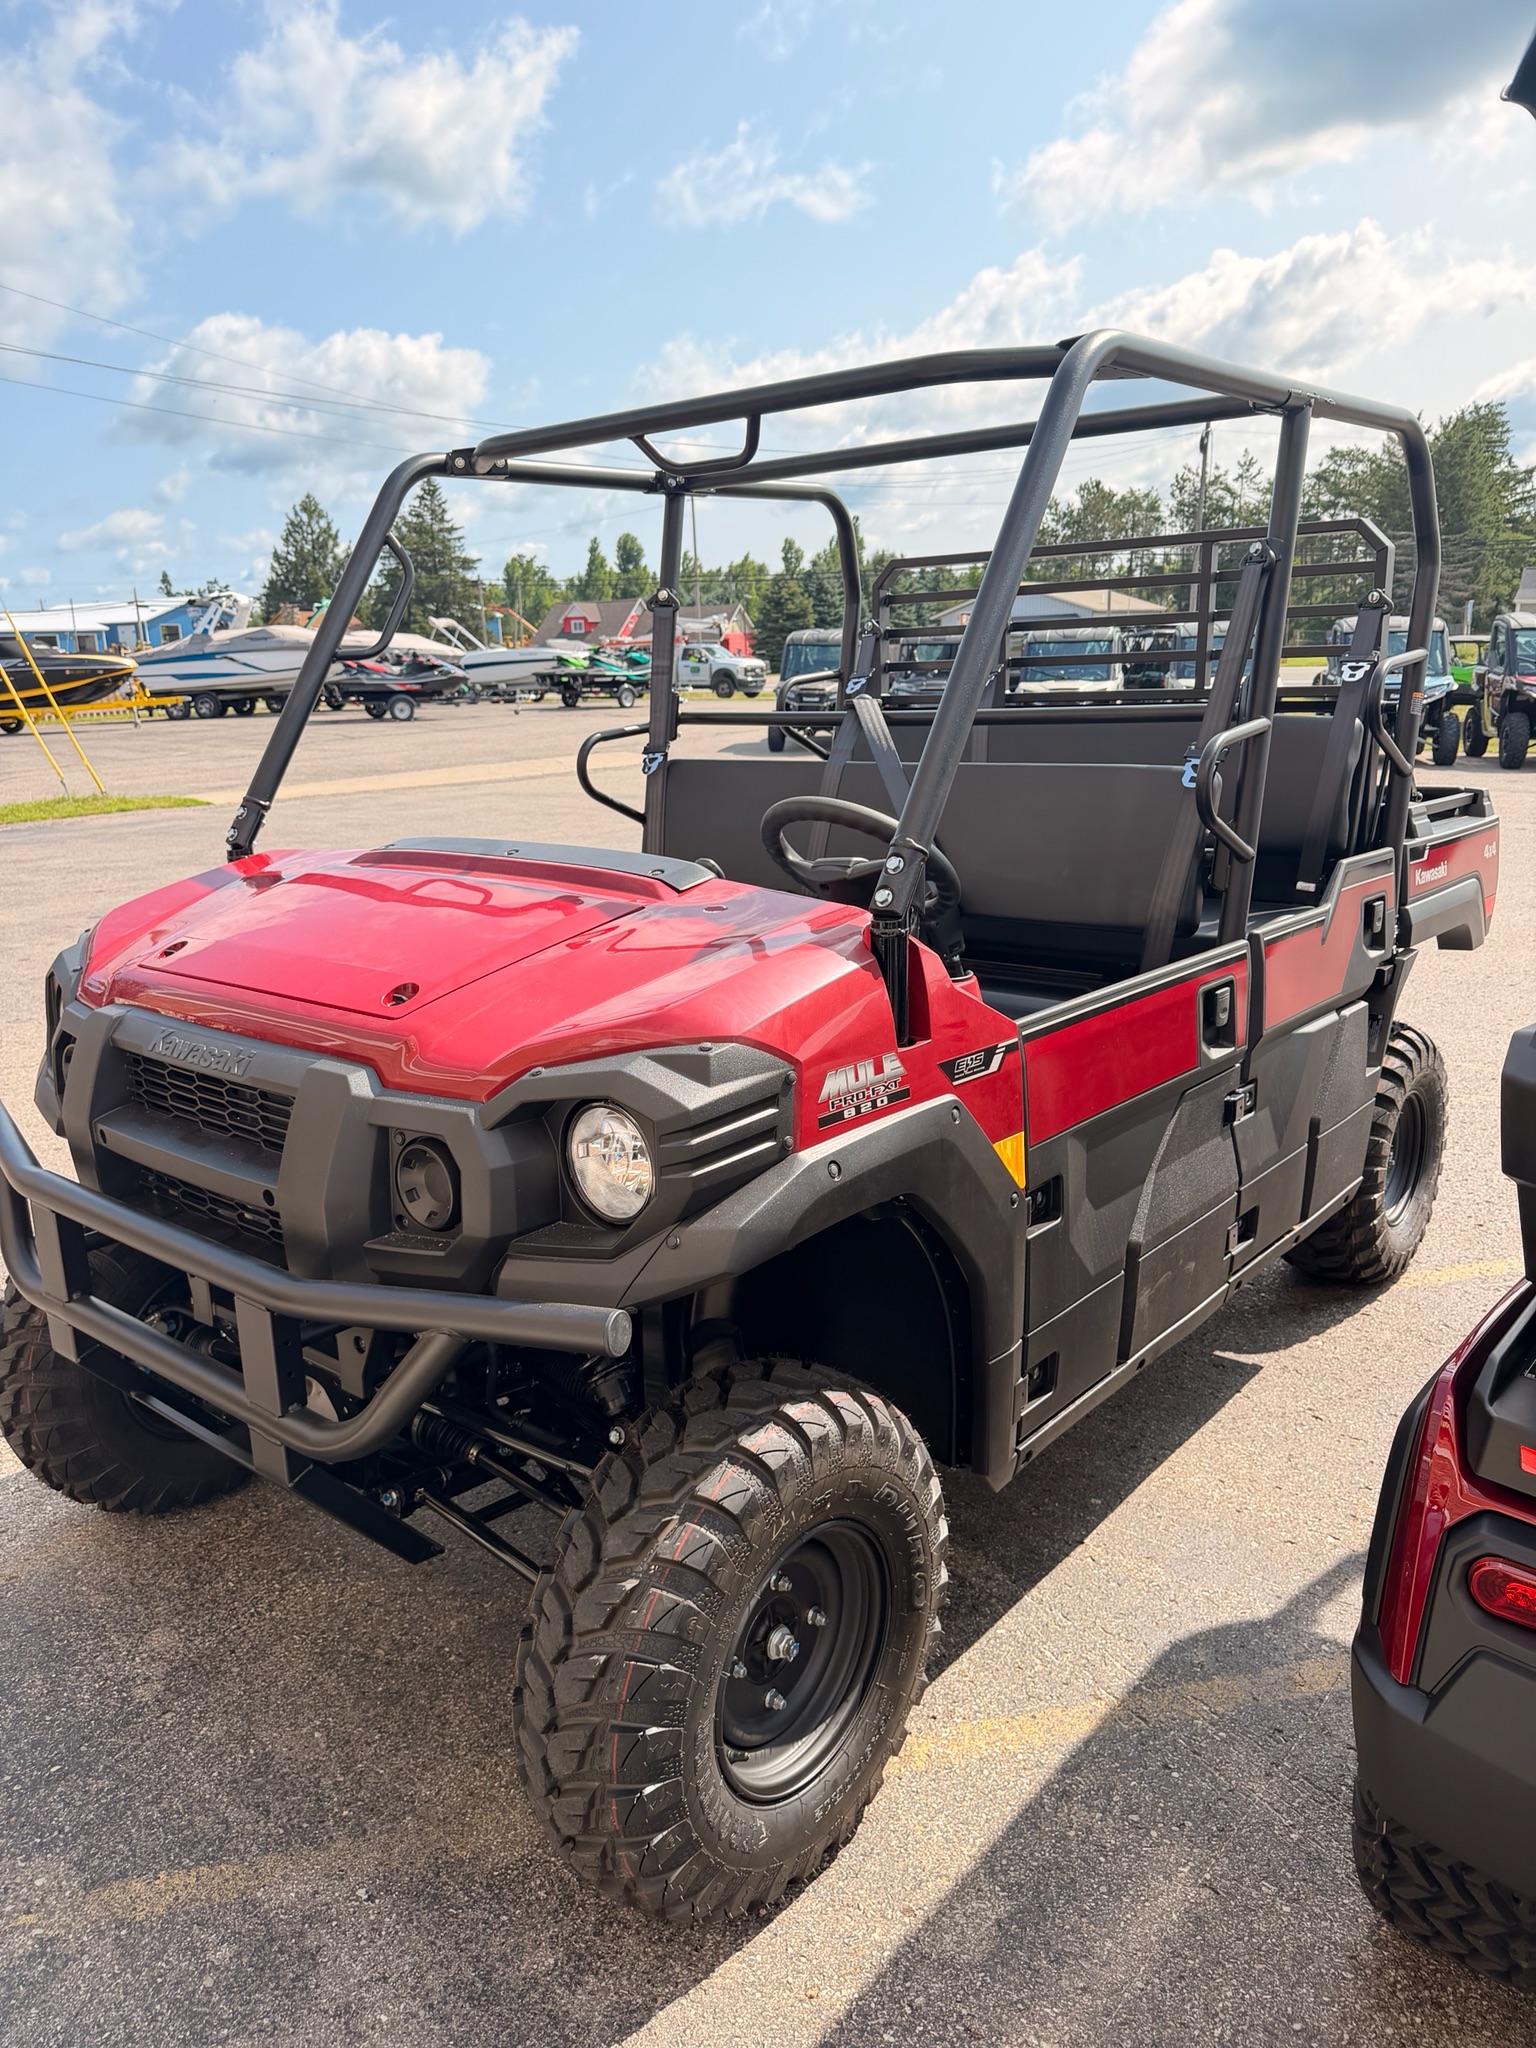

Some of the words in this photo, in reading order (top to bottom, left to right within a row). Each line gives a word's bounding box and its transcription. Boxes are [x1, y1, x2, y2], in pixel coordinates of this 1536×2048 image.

[1483, 841, 1497, 859] 4x4
[1415, 860, 1447, 886] Kawasaki
[148, 1027, 257, 1077] Kawasaki
[954, 1052, 985, 1074] EPS
[818, 1053, 907, 1103] MULE
[830, 1078, 901, 1112] PRO-FXT
[844, 1096, 888, 1119] 820
[872, 1480, 928, 1609] DURO
